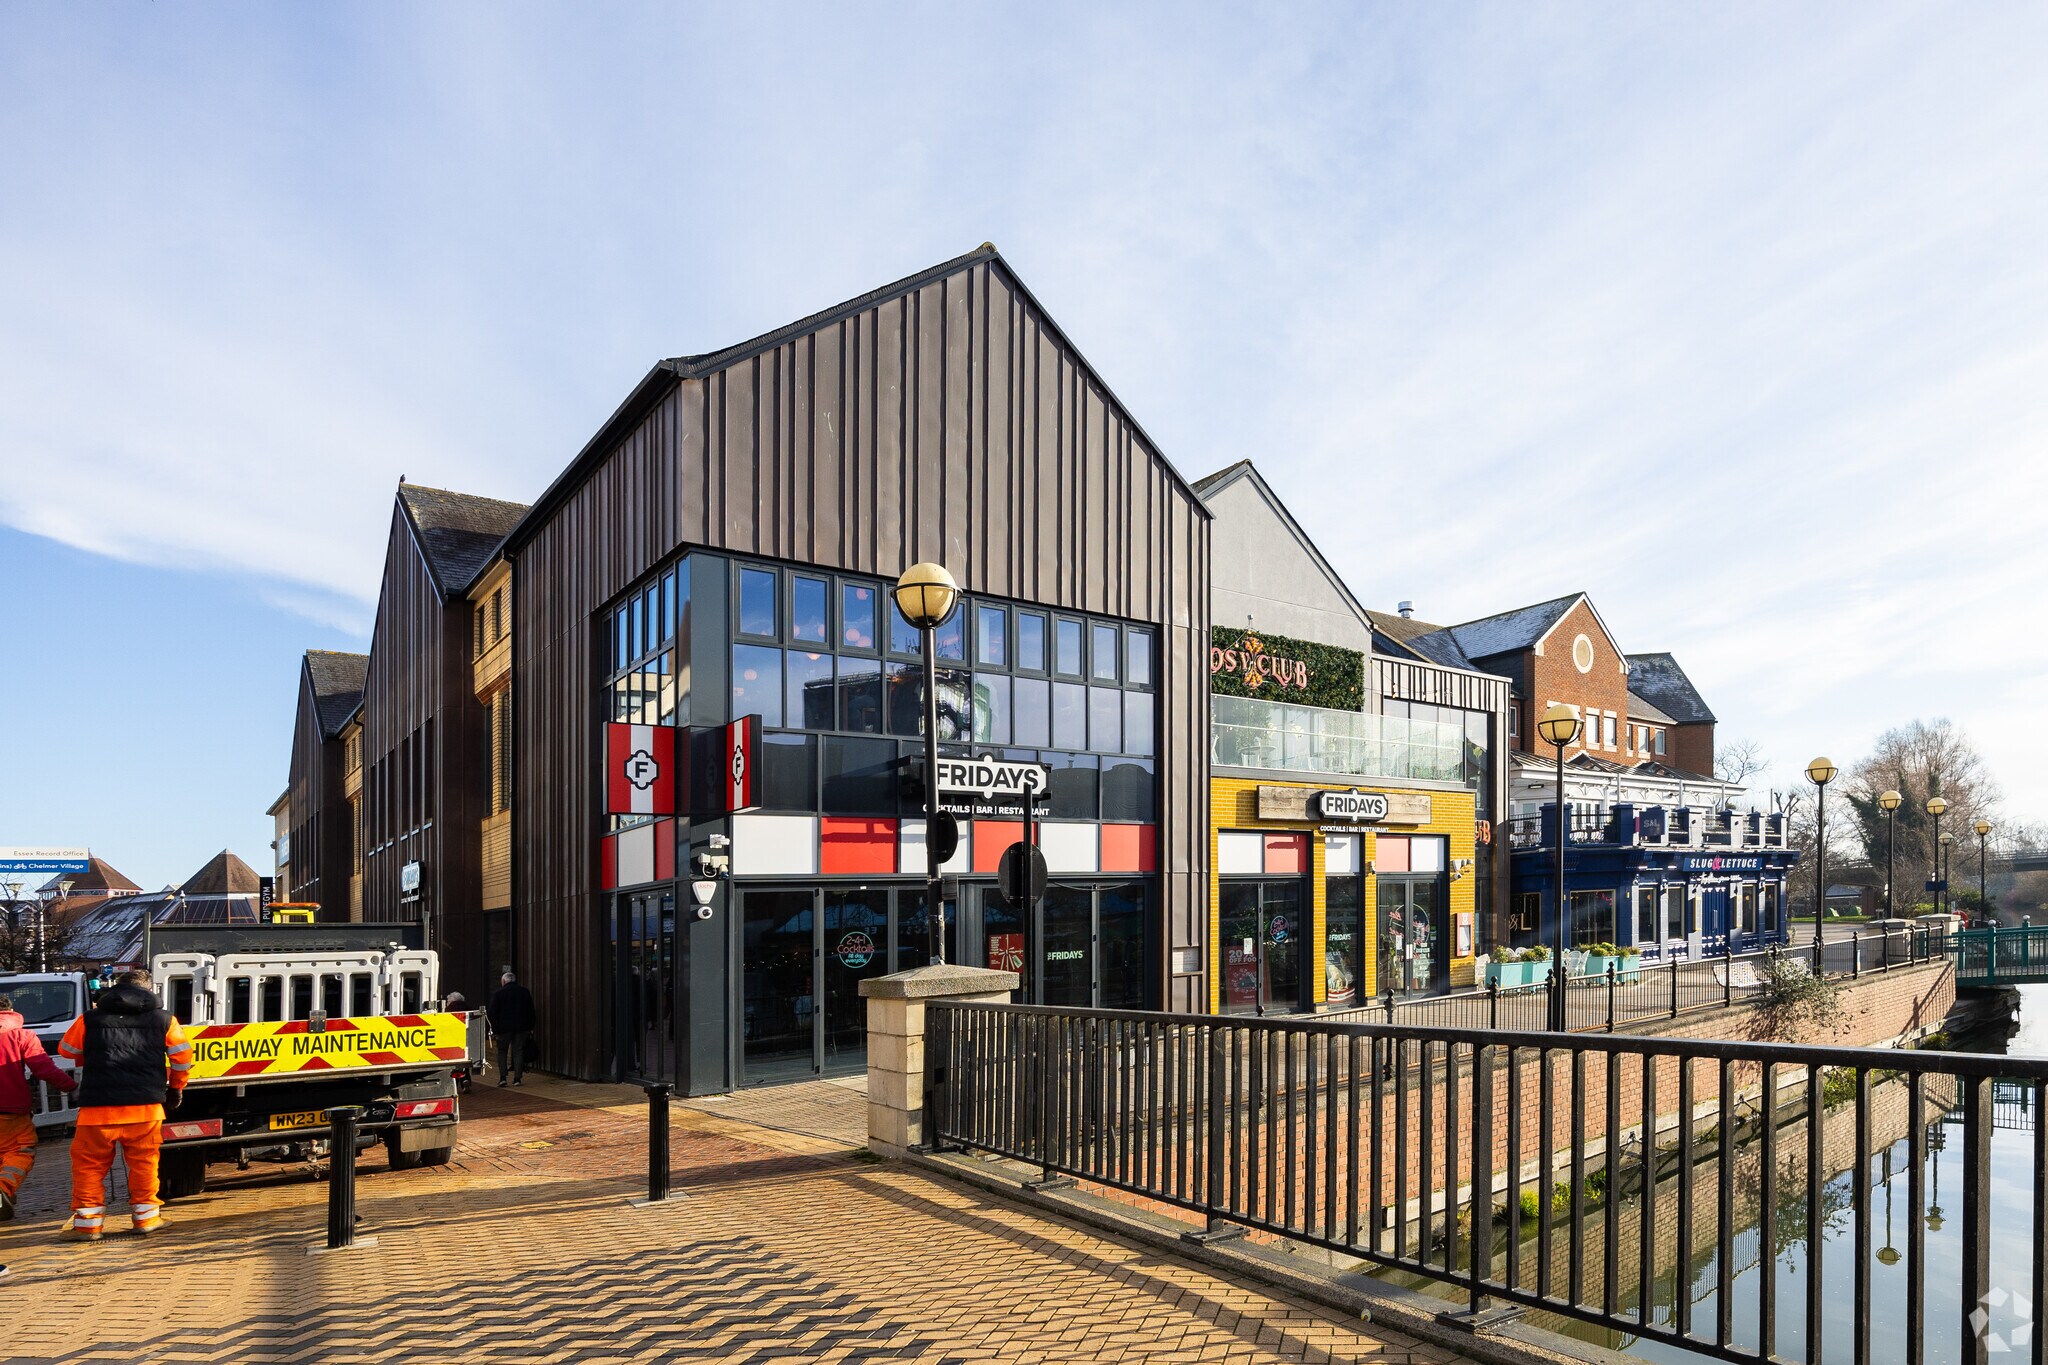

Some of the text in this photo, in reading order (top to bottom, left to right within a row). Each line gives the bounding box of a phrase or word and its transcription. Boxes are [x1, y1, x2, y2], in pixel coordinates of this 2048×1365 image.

[1256, 654, 1308, 689] CLUB
[635, 761, 649, 778] F
[735, 756, 742, 775] F
[937, 763, 1039, 790] FRIDAYS
[976, 805, 993, 814] BAR
[998, 806, 1050, 816] RESTARANT
[1326, 796, 1383, 814] FRIDAYS
[1348, 825, 1358, 833] BAR
[1690, 858, 1713, 869] SLUG
[1721, 858, 1758, 869] LETTUCE
[846, 935, 867, 945] 2-4-1
[1331, 933, 1352, 941] FRIDAYS
[837, 943, 875, 954] Cocktails
[1052, 950, 1084, 961] FRIDAYS
[191, 1028, 437, 1062] HIGHWAY MAINTENANCE
[276, 1112, 316, 1127] WN23
